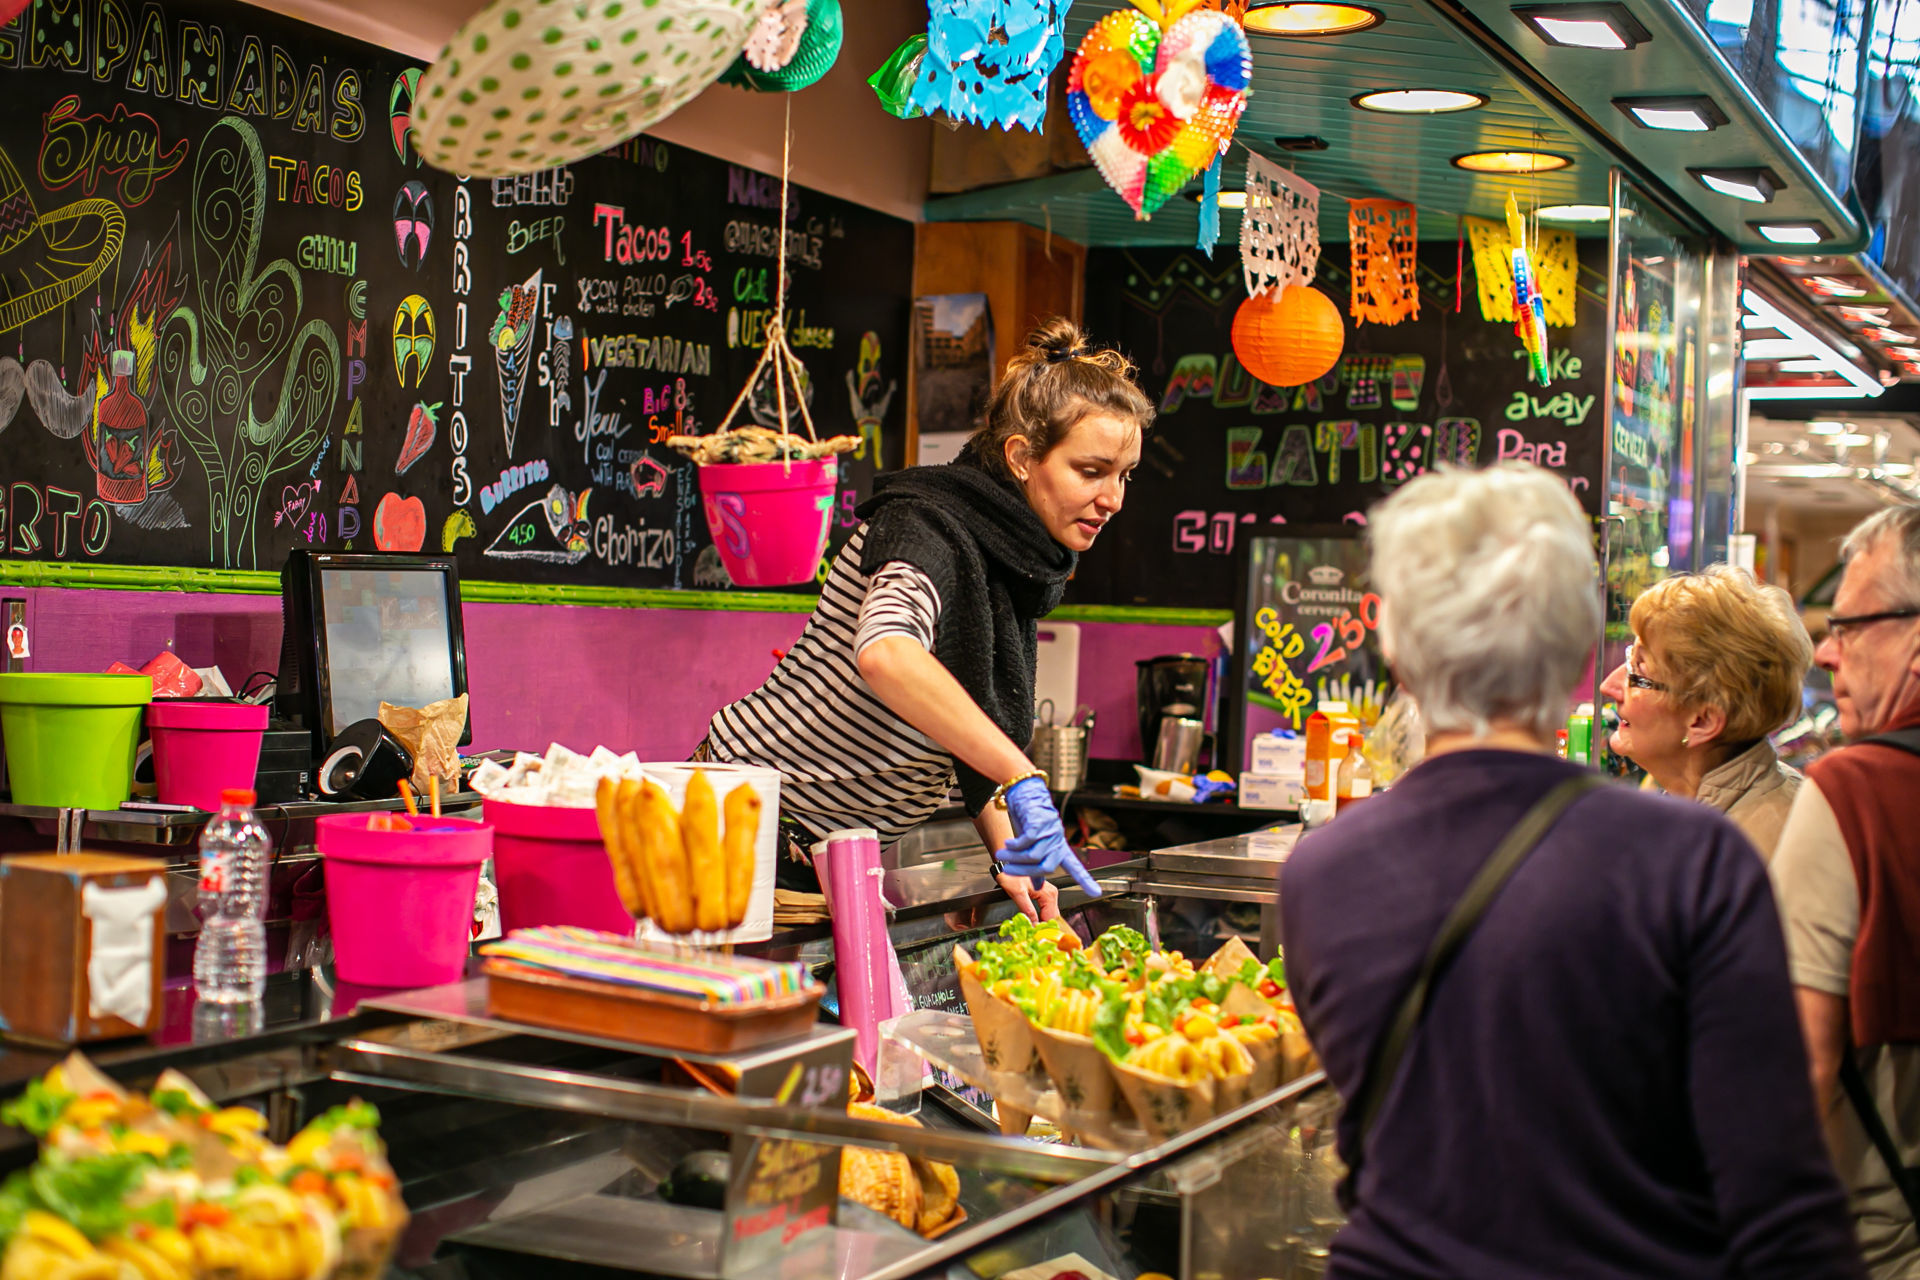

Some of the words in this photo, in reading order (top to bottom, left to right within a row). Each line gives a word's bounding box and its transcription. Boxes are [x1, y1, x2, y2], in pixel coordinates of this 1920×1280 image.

[269, 155, 364, 212] TACOS
[298, 234, 358, 277] CHILI
[507, 216, 566, 267] BEER
[593, 203, 672, 266] Tacos
[449, 172, 473, 505] RRITOS
[590, 333, 711, 376] VEGETARIAN
[1504, 391, 1596, 427] away
[479, 458, 550, 516] BURRITOS
[0, 481, 112, 557] RTO
[594, 513, 675, 569] Chorizo
[1281, 581, 1364, 605] Coronita
[1252, 645, 1313, 730] BEER
